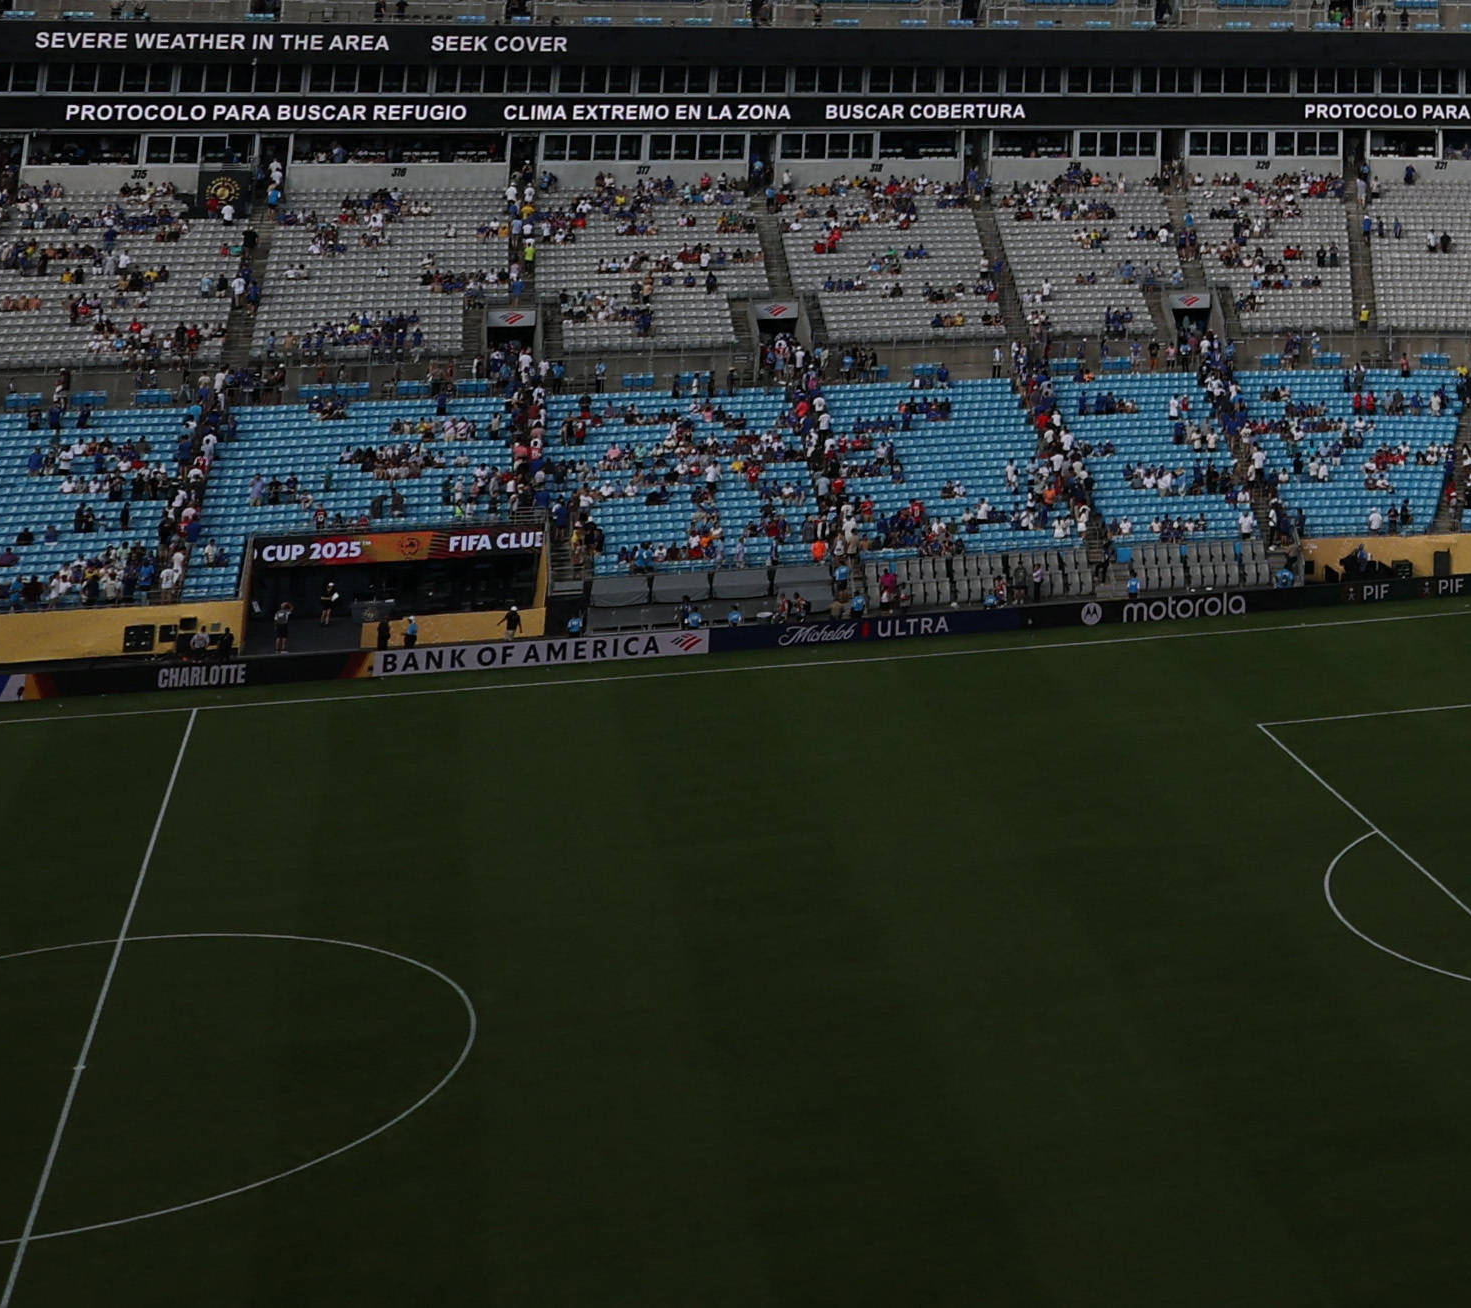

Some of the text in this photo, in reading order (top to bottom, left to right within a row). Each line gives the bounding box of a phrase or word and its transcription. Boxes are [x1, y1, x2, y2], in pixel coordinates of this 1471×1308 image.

[35, 31, 390, 51] SEVERE WEATHER IN THE AREA
[65, 104, 467, 121] PROTOCOLO PARA BUSCAR REFUGIO
[503, 104, 791, 121] CLIMA EXTREMO EN LA ZONA
[825, 103, 1026, 120] BUSCAR COBERTURA
[1304, 103, 1418, 119] PROTOCOLO
[1422, 104, 1471, 120] PARA
[131, 169, 148, 179] 315
[261, 542, 307, 564] CUP
[448, 533, 491, 554] FIFA
[1362, 584, 1390, 602] PIF
[1122, 592, 1247, 624] motorola
[777, 615, 949, 648] Michelob ULTRA
[381, 635, 661, 674] BANK OF AMERICA
[157, 662, 247, 689] CHARLOTTE
